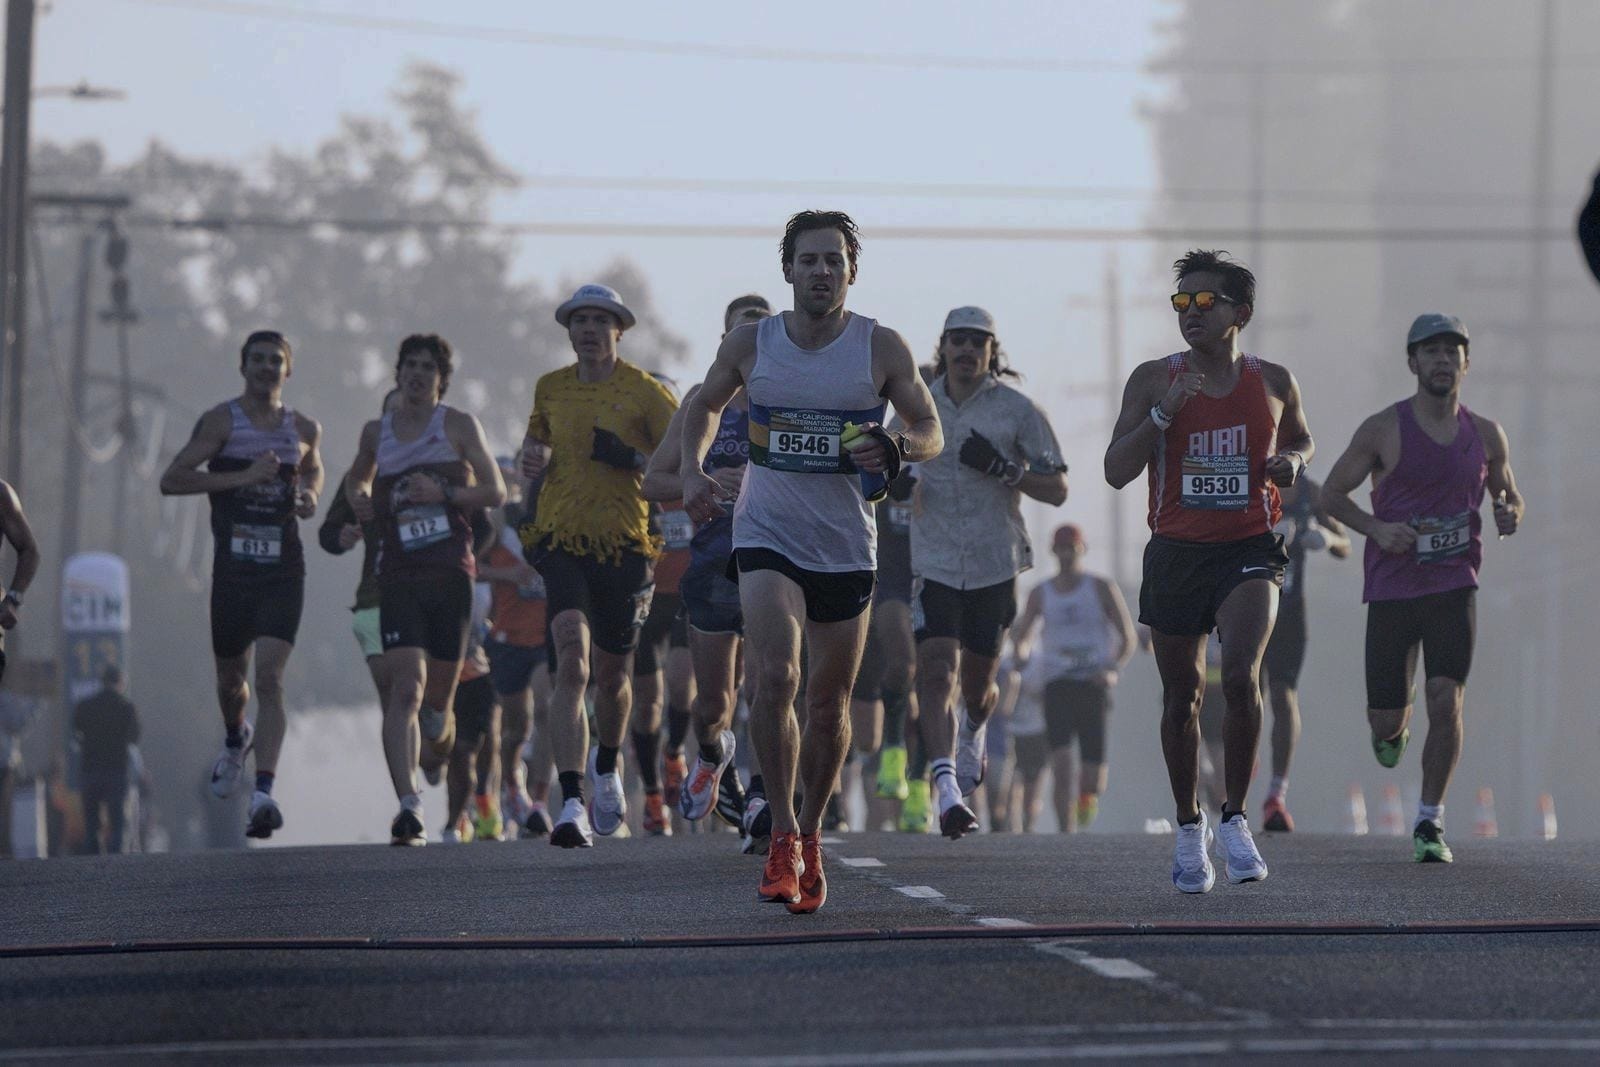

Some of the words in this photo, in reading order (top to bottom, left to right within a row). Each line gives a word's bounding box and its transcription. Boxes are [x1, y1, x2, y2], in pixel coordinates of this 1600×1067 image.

[790, 419, 841, 428] INTERNATIONAL
[802, 413, 841, 422] CALIFORNIA
[803, 425, 841, 433] MARATHON
[778, 433, 830, 455] 9546
[803, 459, 839, 468] MARATHON
[1191, 476, 1240, 494] 9530
[410, 520, 437, 538] 612
[242, 540, 269, 554] 613
[1431, 531, 1459, 549] 623
